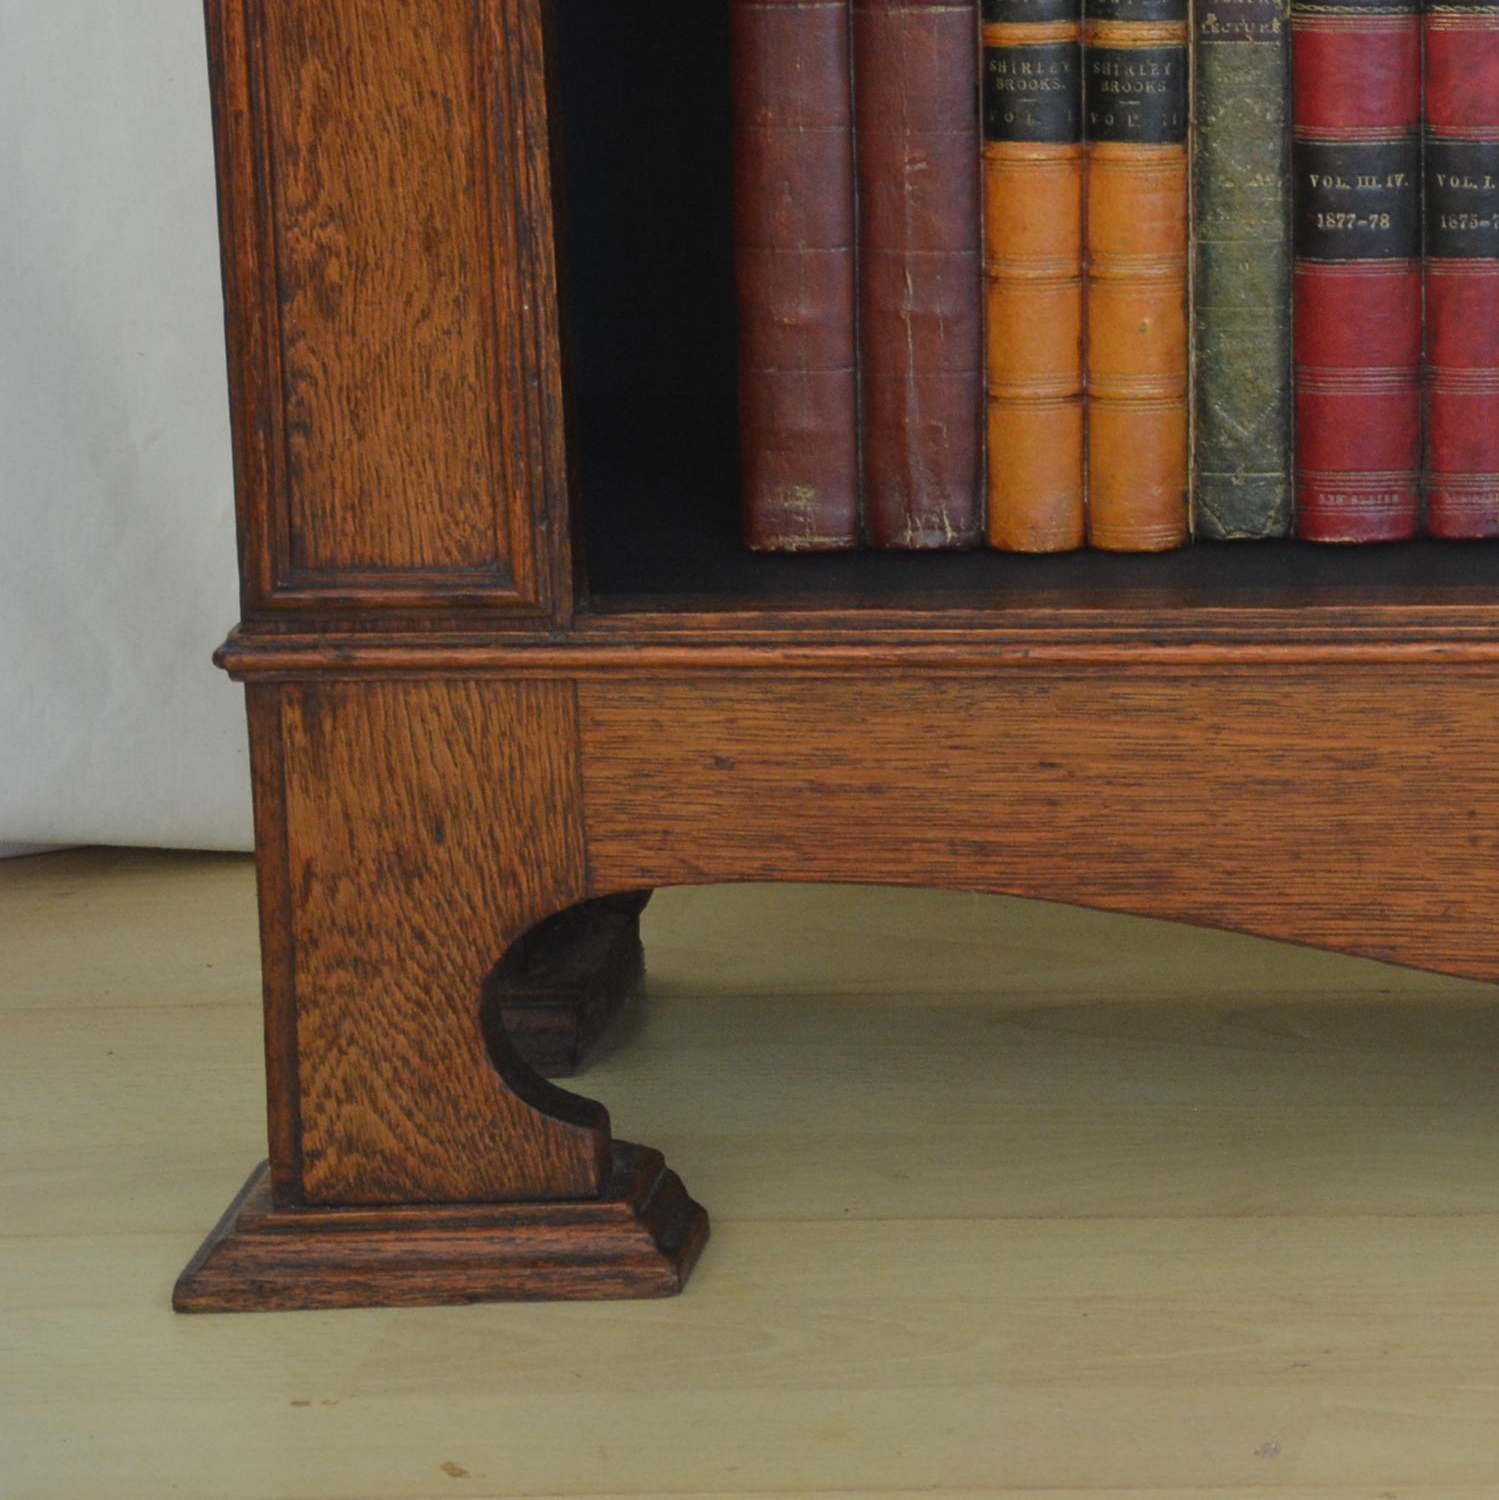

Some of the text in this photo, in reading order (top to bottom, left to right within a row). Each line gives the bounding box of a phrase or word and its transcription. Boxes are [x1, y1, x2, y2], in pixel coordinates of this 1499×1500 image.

[989, 60, 1071, 77] SHIRLEY
[1092, 61, 1173, 78] SHIRLEY
[1309, 173, 1353, 191] VOL.
[1386, 172, 1410, 190] IV.
[1436, 173, 1479, 191] VOL.
